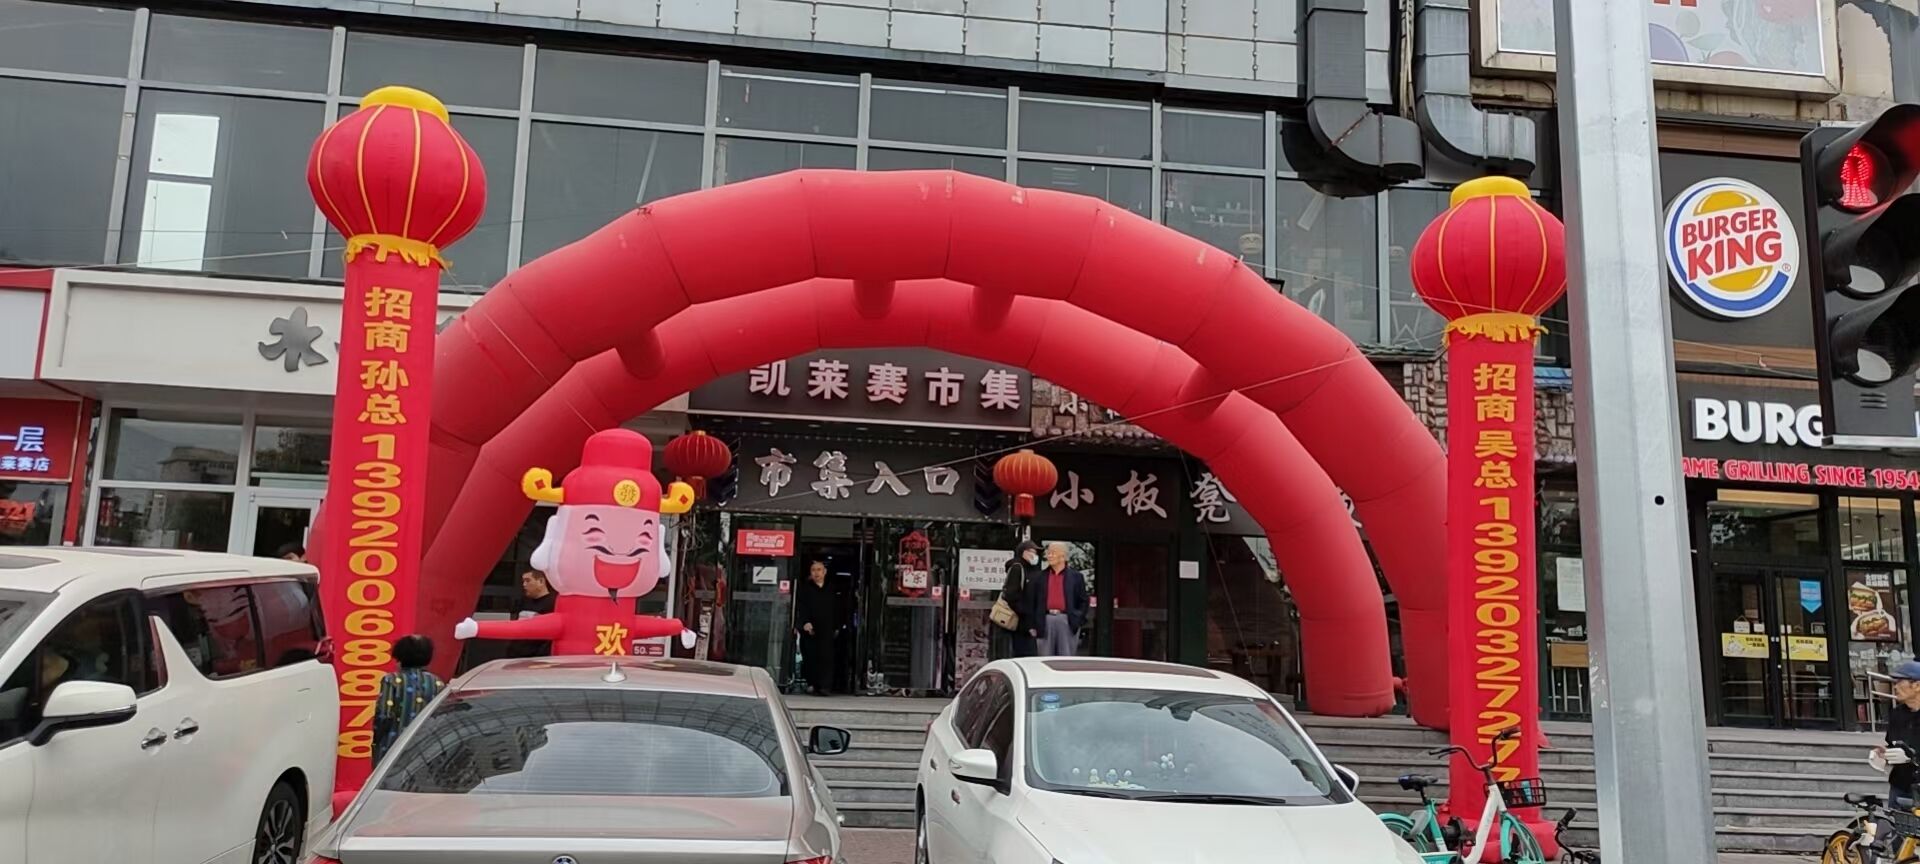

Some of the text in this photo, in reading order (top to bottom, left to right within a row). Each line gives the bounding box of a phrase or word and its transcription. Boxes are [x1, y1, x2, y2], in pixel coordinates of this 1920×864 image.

[1682, 208, 1777, 248] BURGER
[1686, 231, 1783, 281] KING
[258, 306, 329, 373] 水
[748, 358, 1021, 411] 凯莱赛市集
[754, 447, 961, 499] 市集入口
[1723, 460, 1811, 485] GRILLING
[1814, 464, 1866, 488] SINCE
[594, 622, 628, 656] 欢
